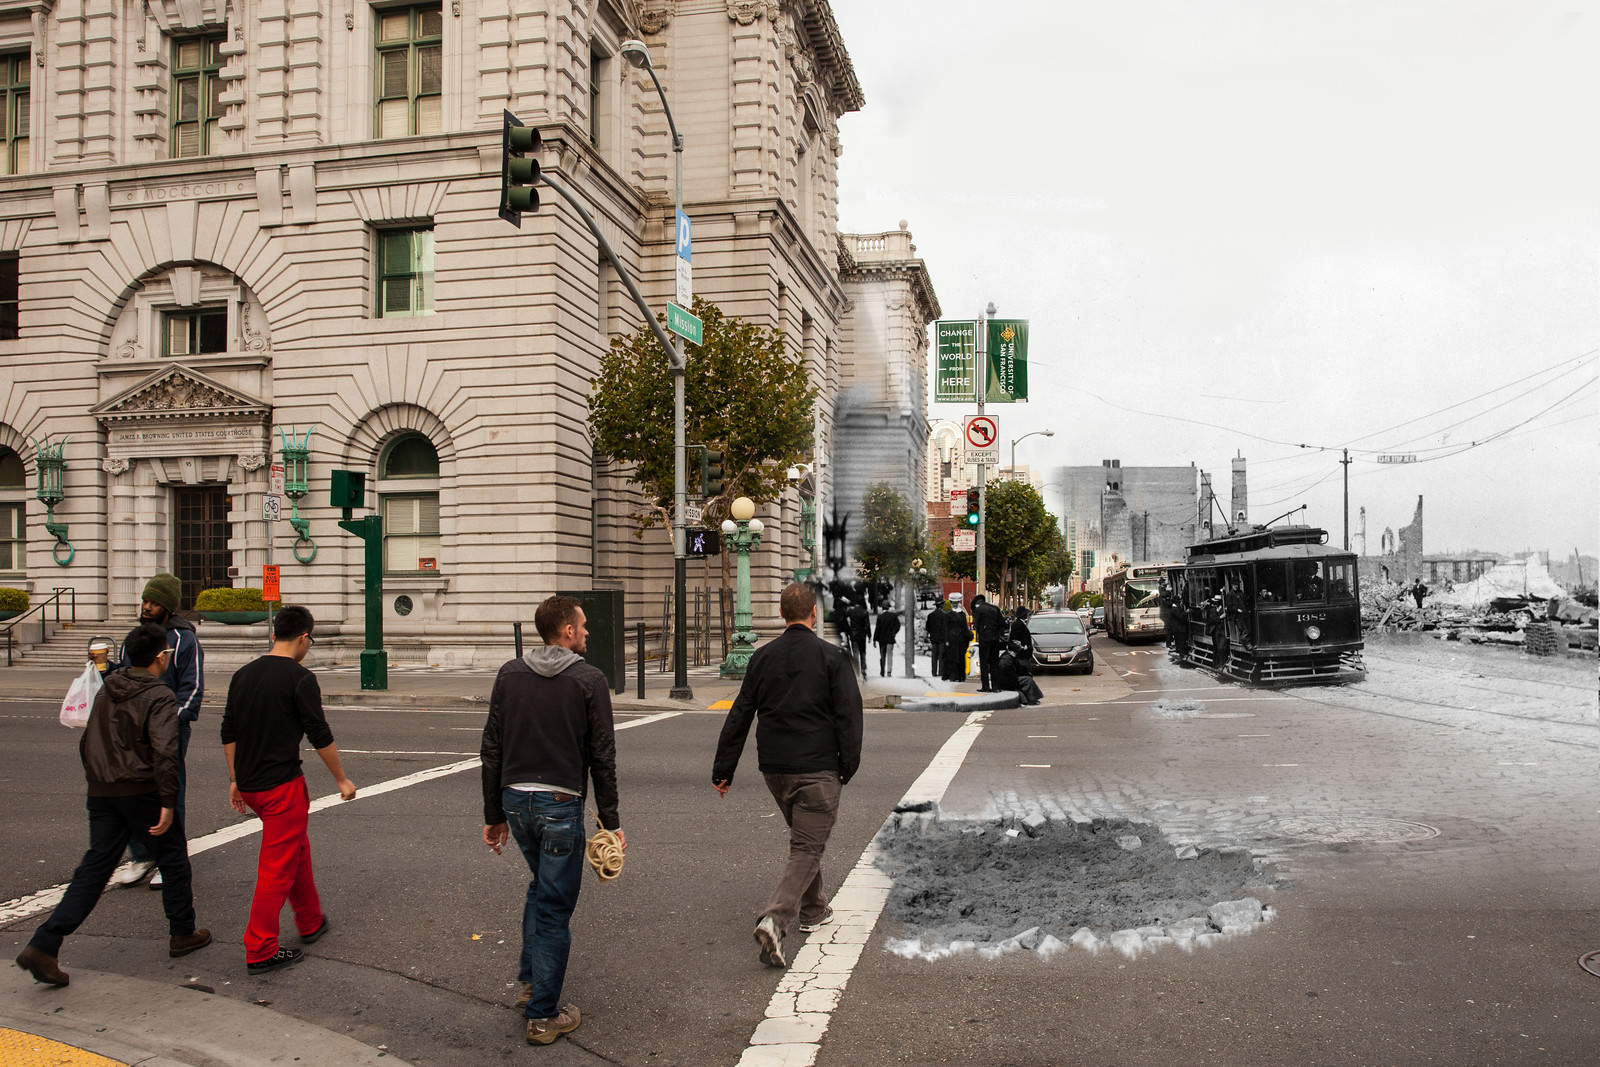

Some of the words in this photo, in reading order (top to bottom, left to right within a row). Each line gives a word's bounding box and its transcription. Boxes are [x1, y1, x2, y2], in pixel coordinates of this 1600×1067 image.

[679, 216, 690, 252] P
[674, 312, 697, 336] Mission
[941, 377, 971, 386] HERE
[1008, 386, 1014, 394] OF
[171, 431, 193, 439] UNITED
[215, 429, 252, 437] COURTHOUSE
[1297, 613, 1327, 621] 1382
